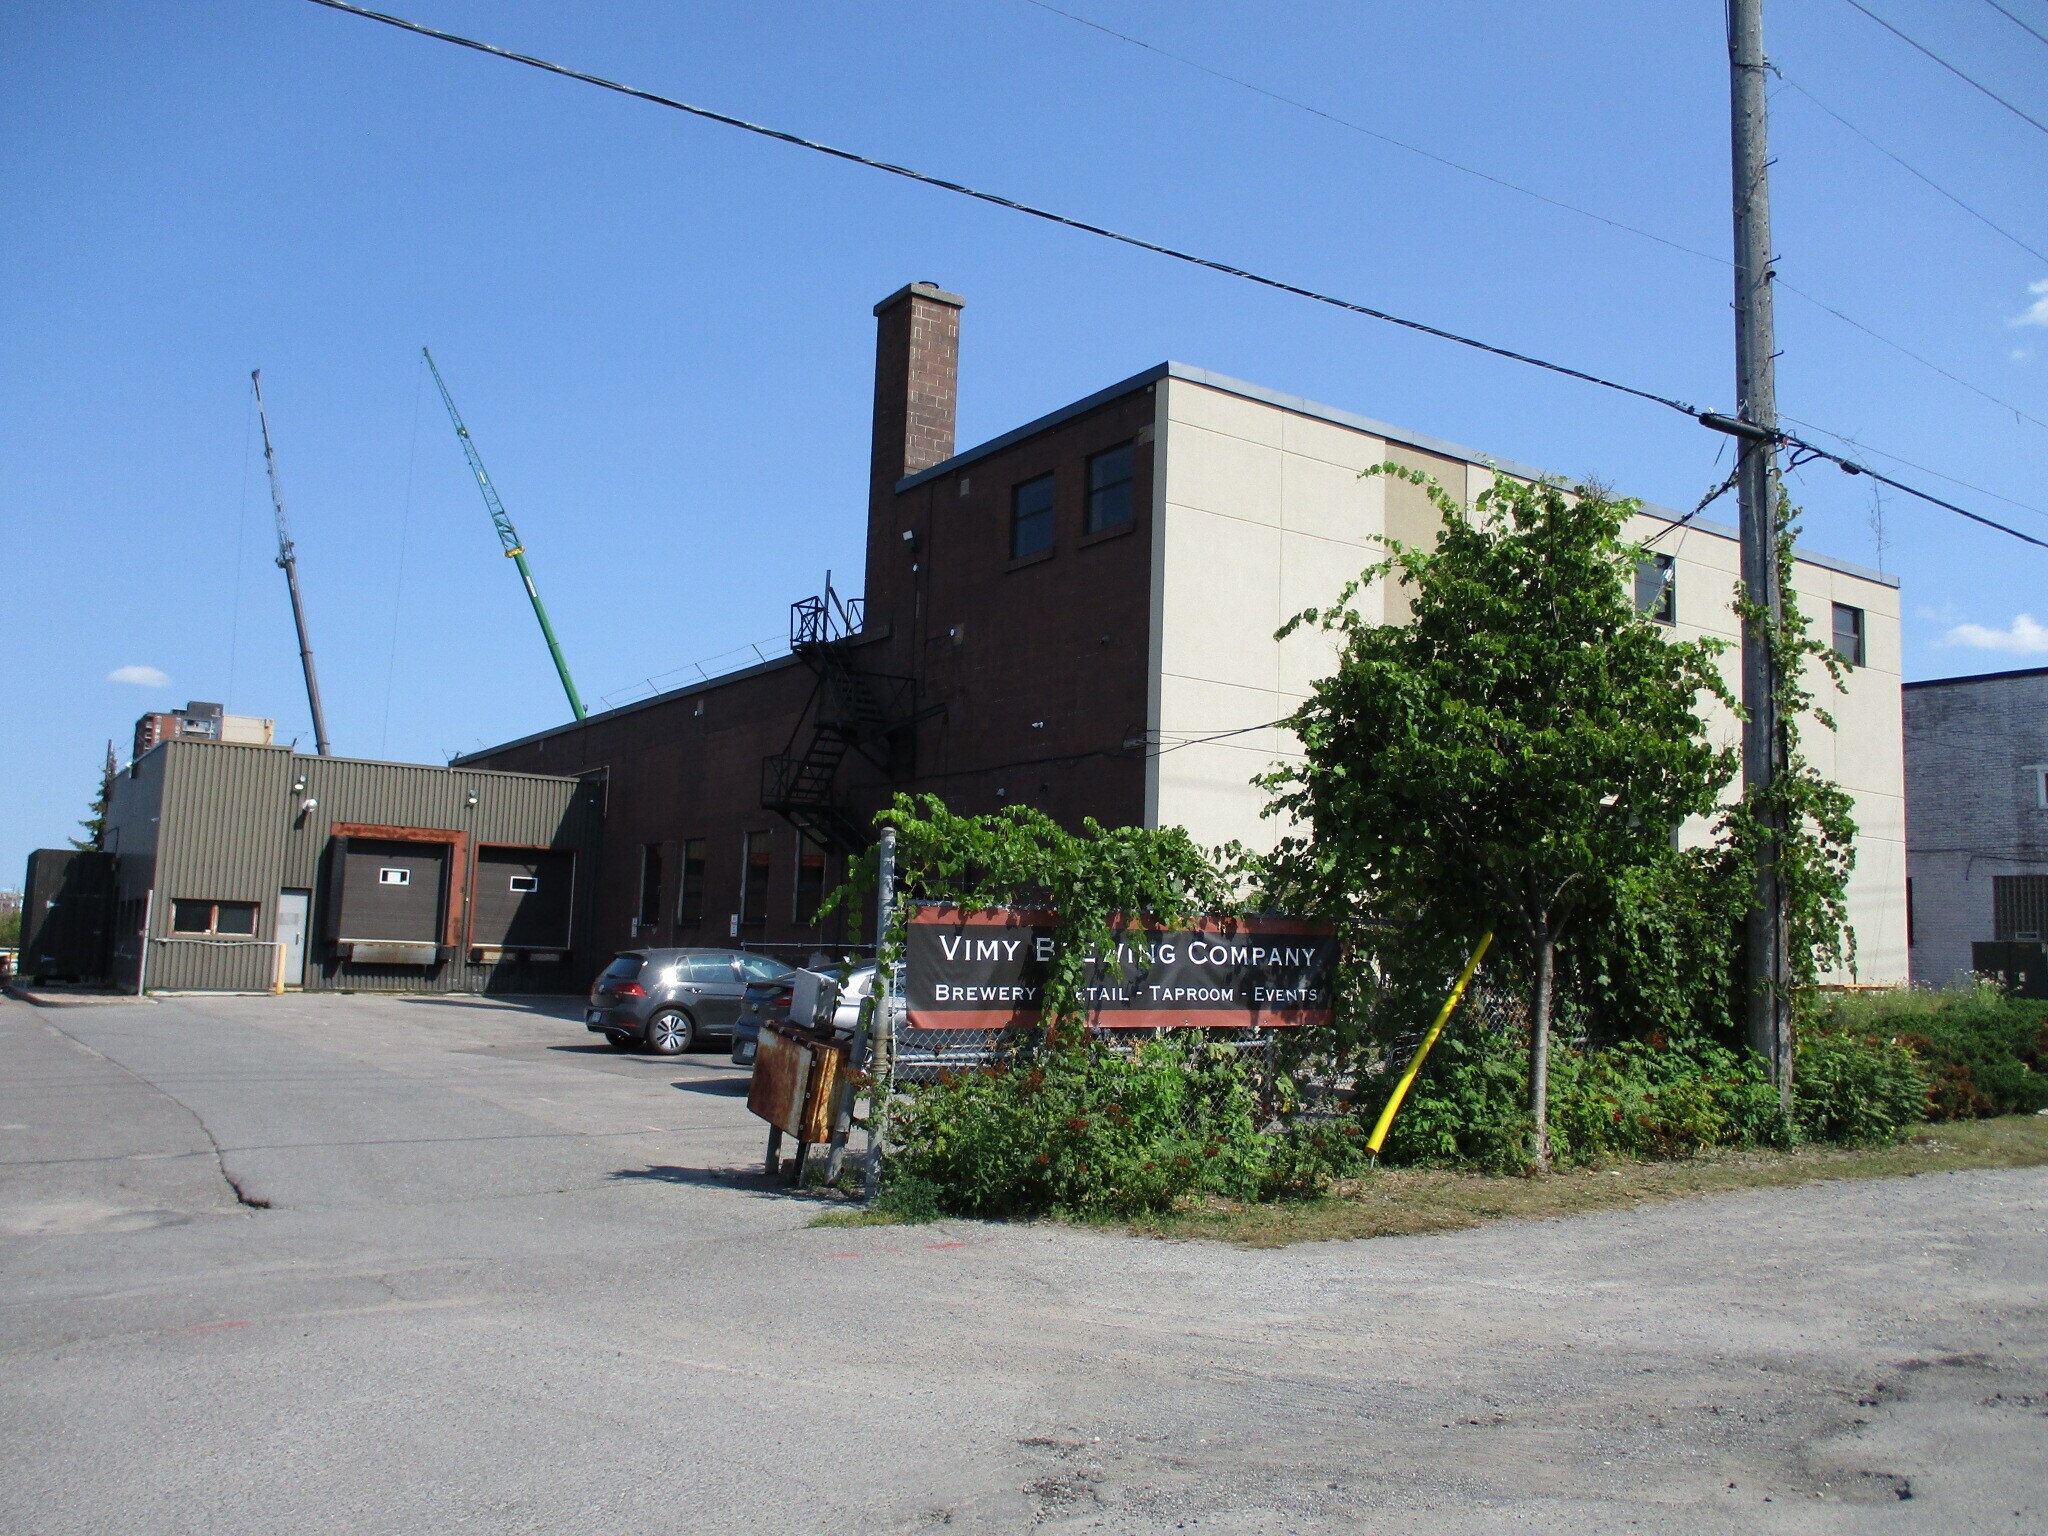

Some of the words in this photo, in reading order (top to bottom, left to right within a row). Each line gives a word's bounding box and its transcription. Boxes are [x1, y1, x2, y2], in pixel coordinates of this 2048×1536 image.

[939, 935, 1021, 962] VIMY
[1036, 938, 1176, 965] BEWING
[1188, 941, 1316, 967] COMPANY
[935, 984, 1037, 1001] BREWERY
[1072, 986, 1130, 1001] ETAIL
[1149, 985, 1234, 1001] TAPROOM
[1254, 986, 1318, 1002] EVENTS
